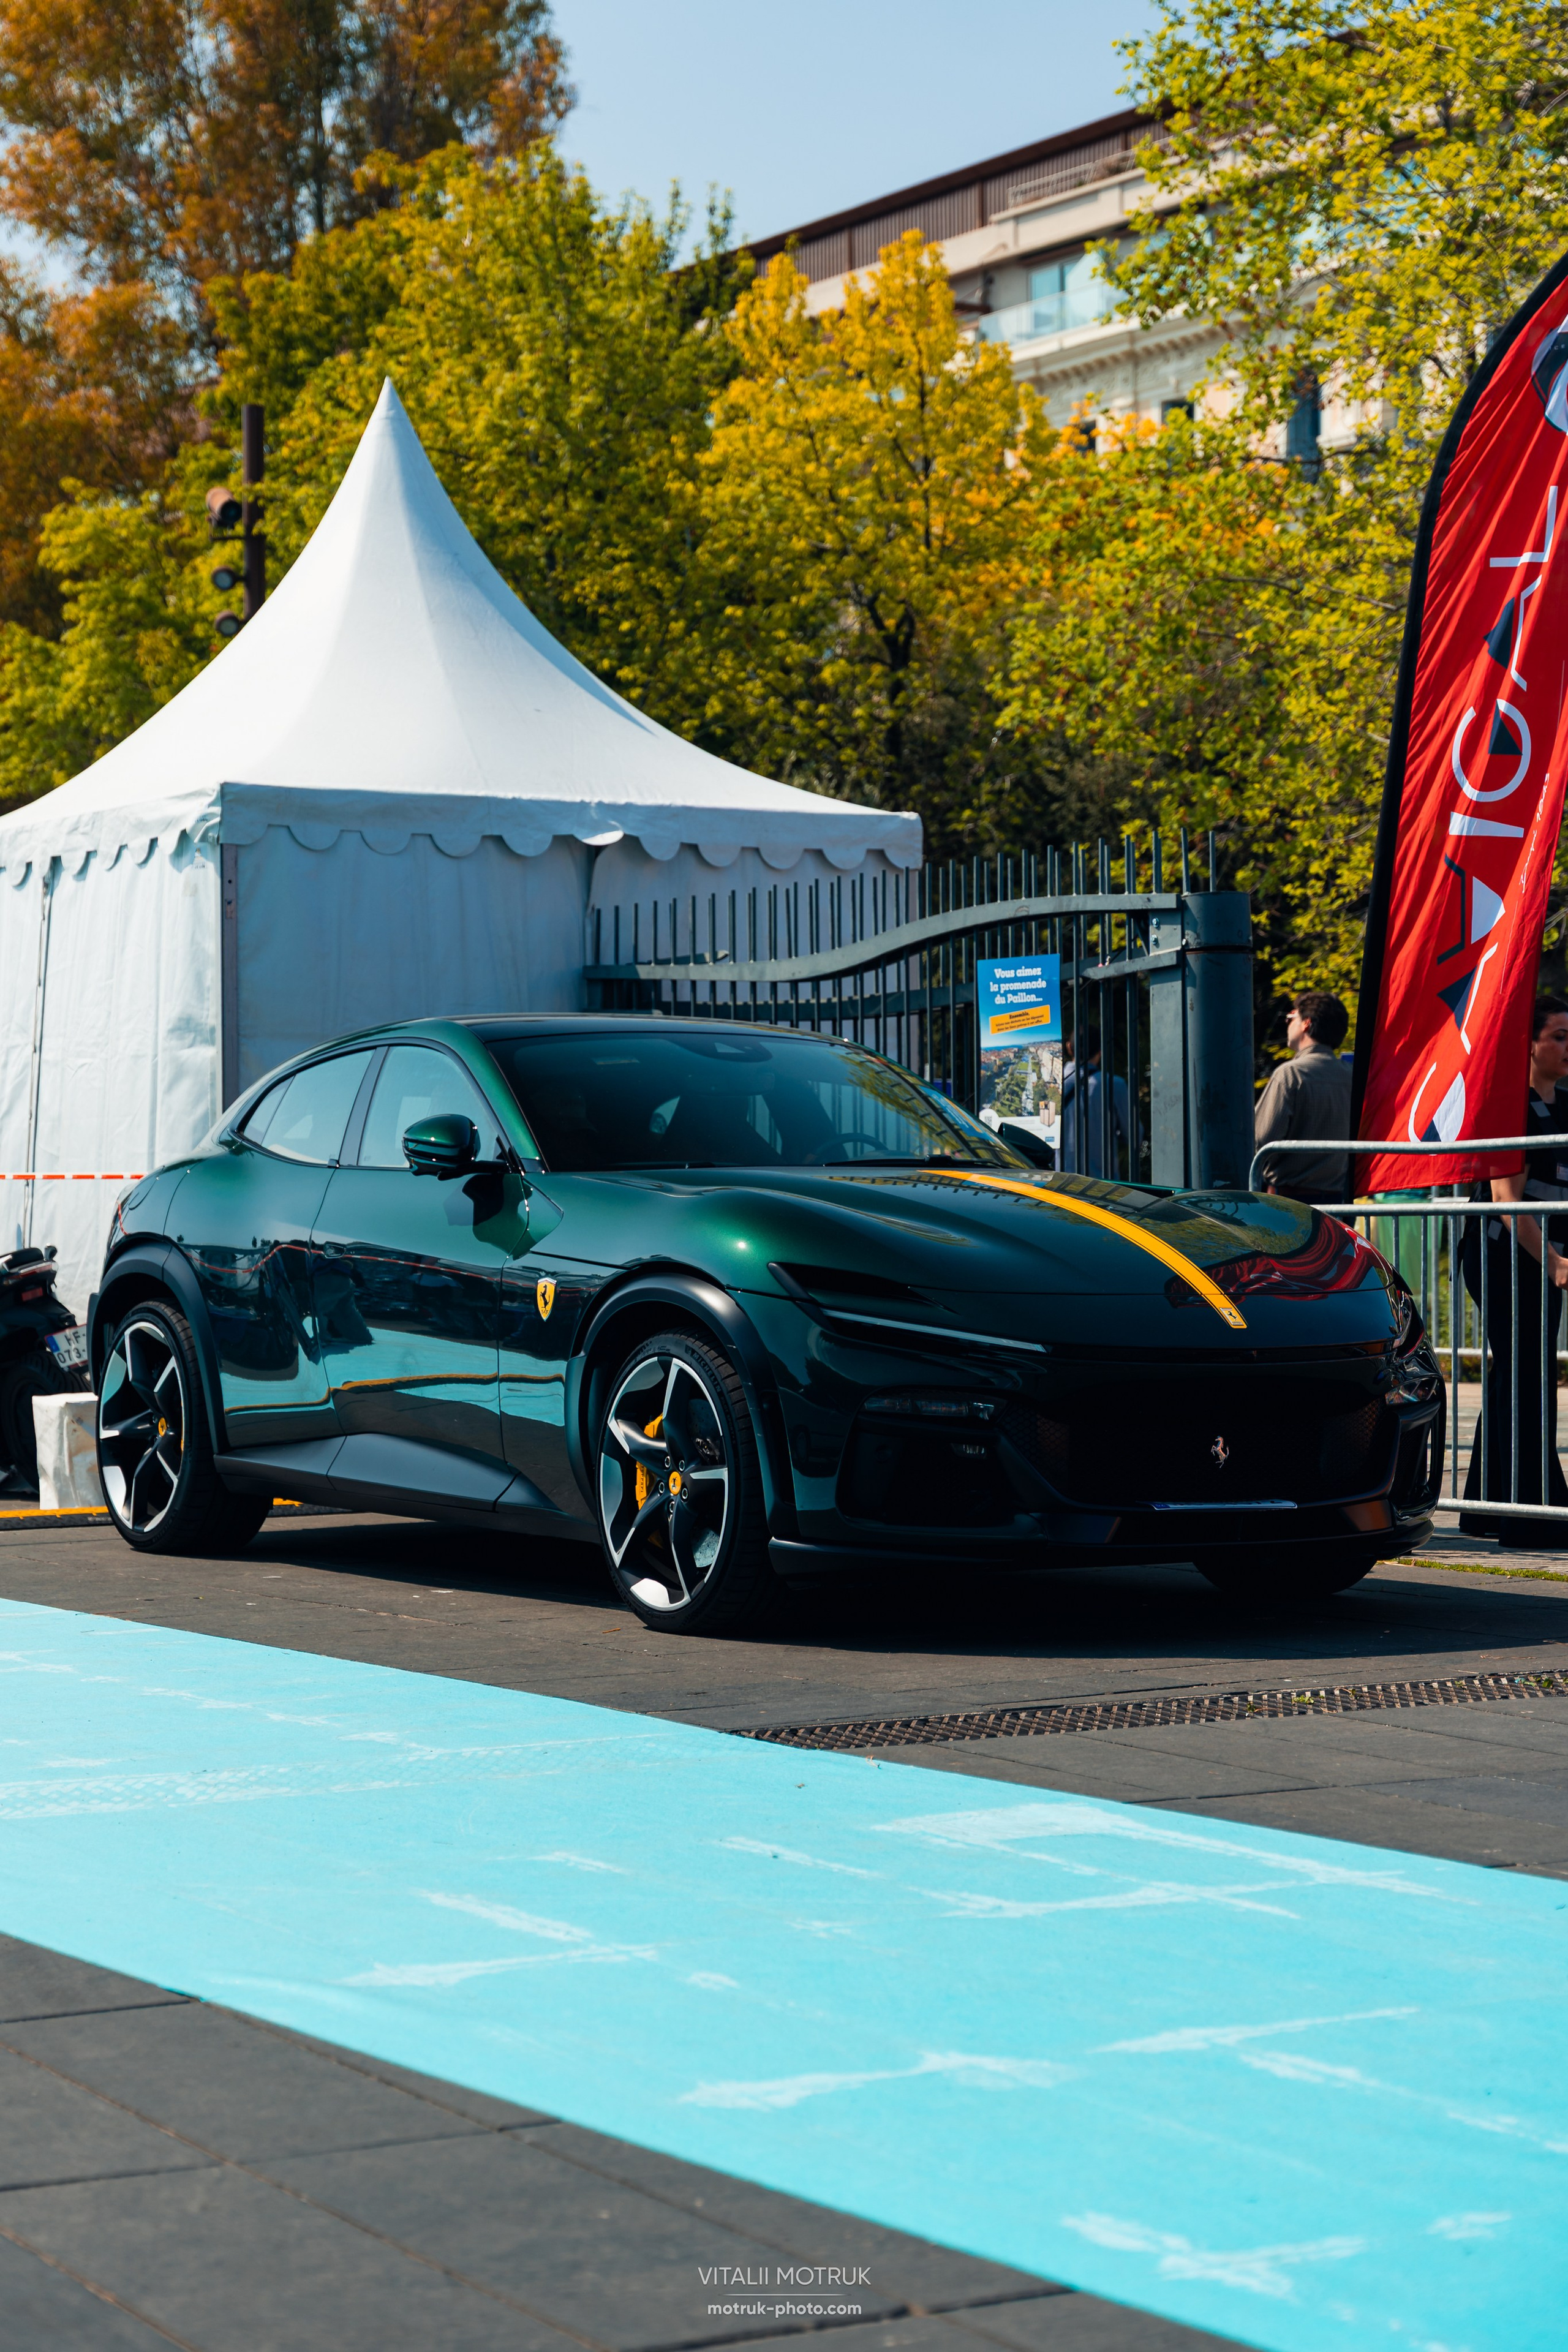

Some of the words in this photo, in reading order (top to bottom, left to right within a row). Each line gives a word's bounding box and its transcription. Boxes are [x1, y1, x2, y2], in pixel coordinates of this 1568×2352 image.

[1536, 773, 1550, 823] 1943
[1408, 485, 1558, 1156] CAVIGAL
[990, 981, 999, 992] la
[1000, 978, 1047, 993] promenade
[994, 968, 1015, 978] Vous
[1016, 966, 1042, 977] aimez
[994, 994, 1006, 1005] du
[1007, 992, 1043, 1003] Paillon...
[693, 1352, 722, 1393] MICHELIN
